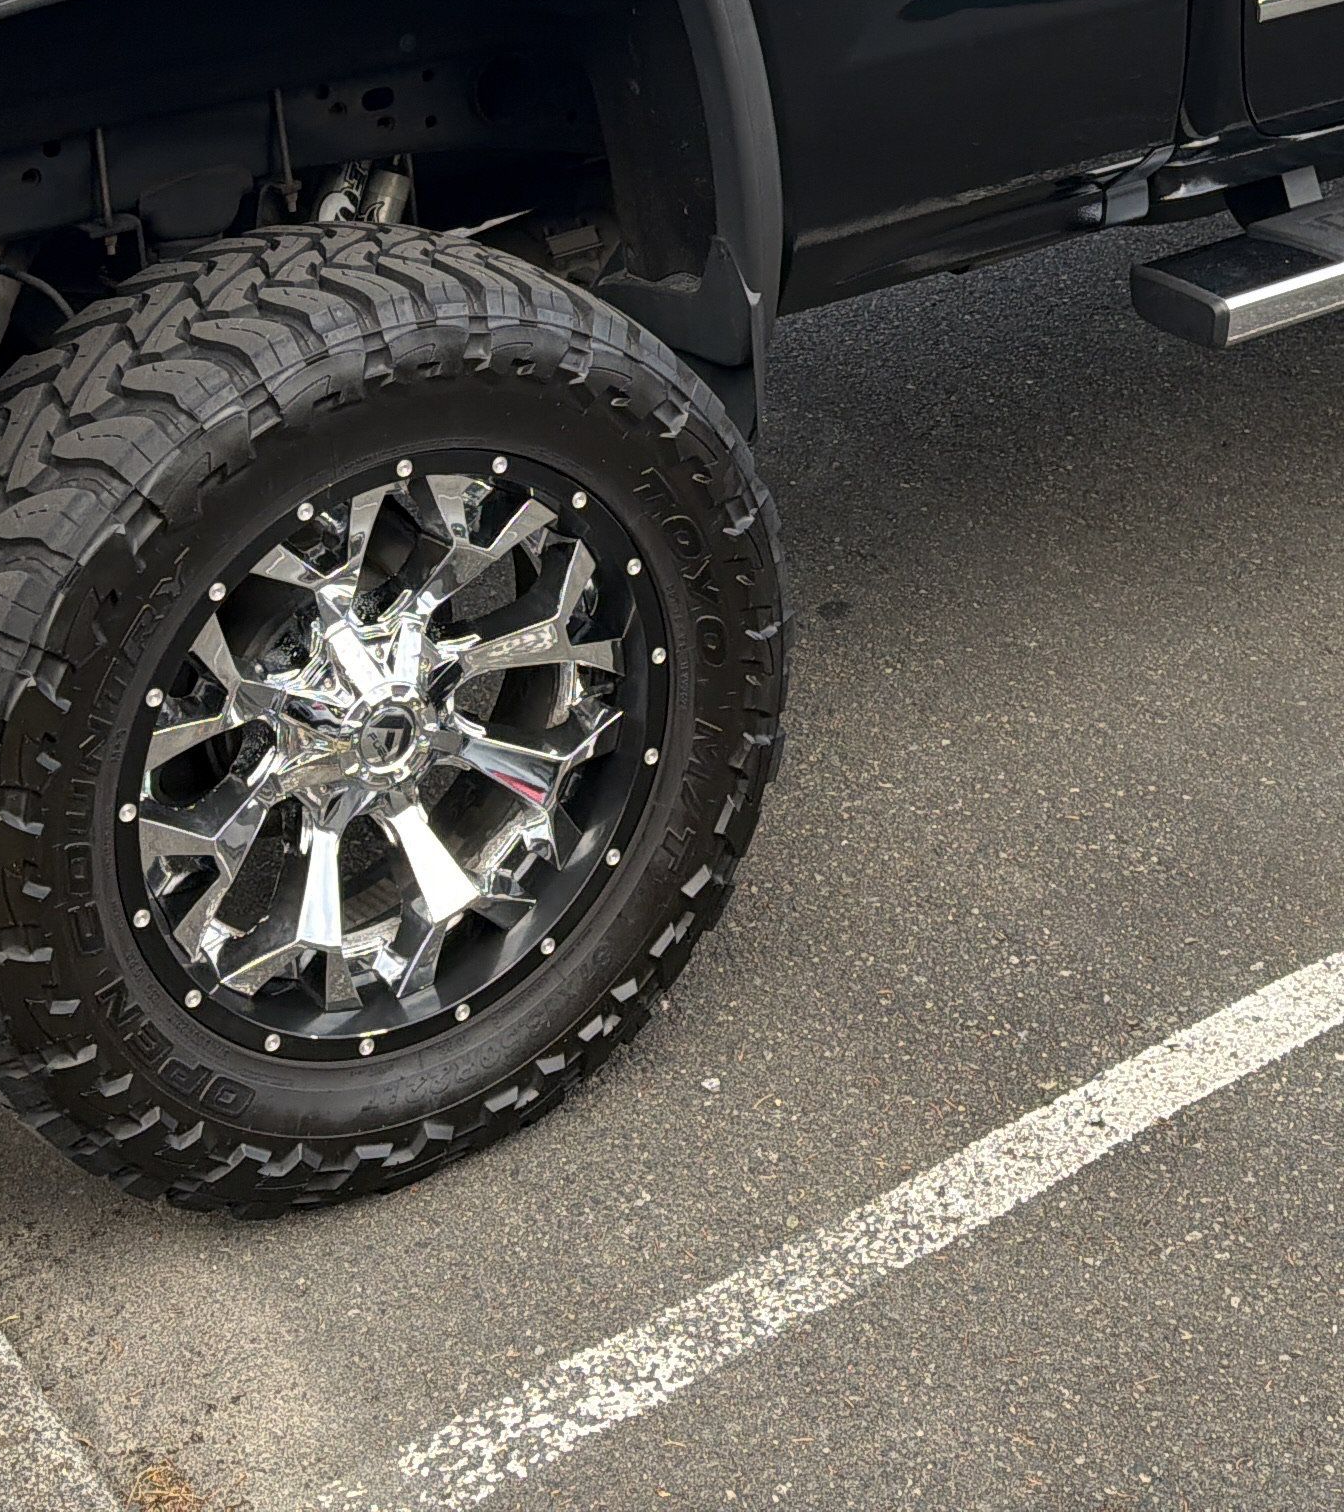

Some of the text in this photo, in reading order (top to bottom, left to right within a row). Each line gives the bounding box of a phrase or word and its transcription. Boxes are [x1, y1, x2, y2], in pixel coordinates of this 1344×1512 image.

[634, 467, 728, 668] TOYO
[59, 545, 192, 956] COUNTRY
[95, 972, 256, 1119] OPEN
